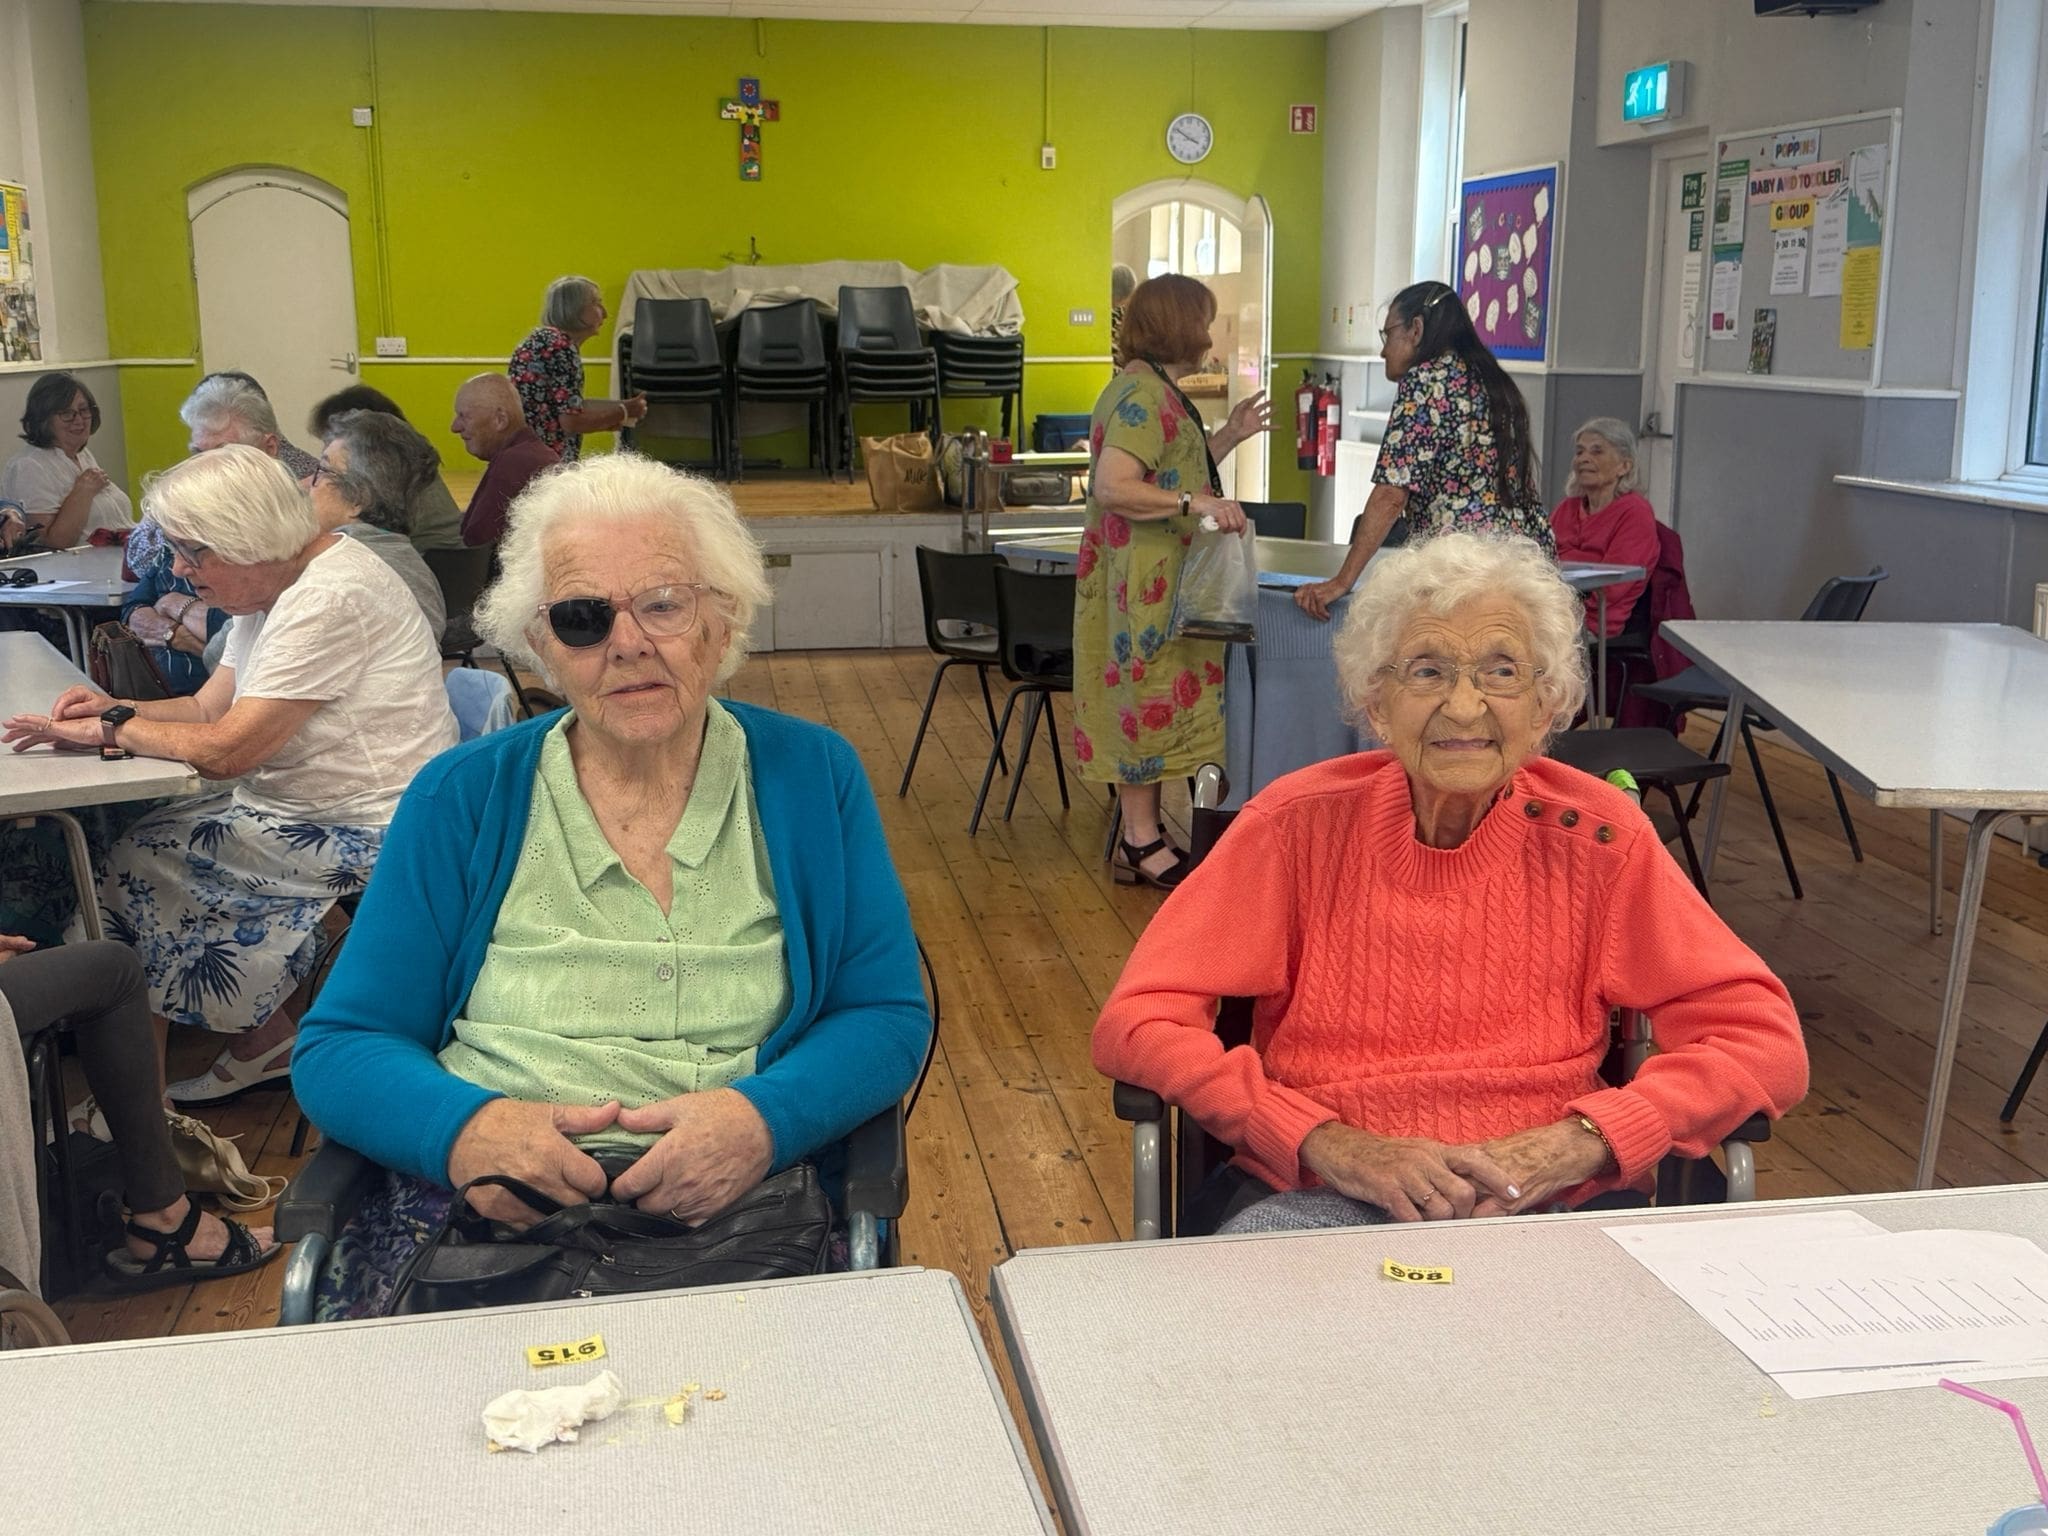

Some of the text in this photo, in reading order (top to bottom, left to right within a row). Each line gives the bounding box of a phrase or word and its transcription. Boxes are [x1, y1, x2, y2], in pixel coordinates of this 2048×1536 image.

[1685, 178, 1698, 191] Fire
[1750, 177, 1776, 196] BABY
[1684, 194, 1697, 206] exit
[1775, 203, 1810, 221] GROUP
[1390, 1266, 1443, 1281] 908
[537, 1342, 597, 1361] 915
